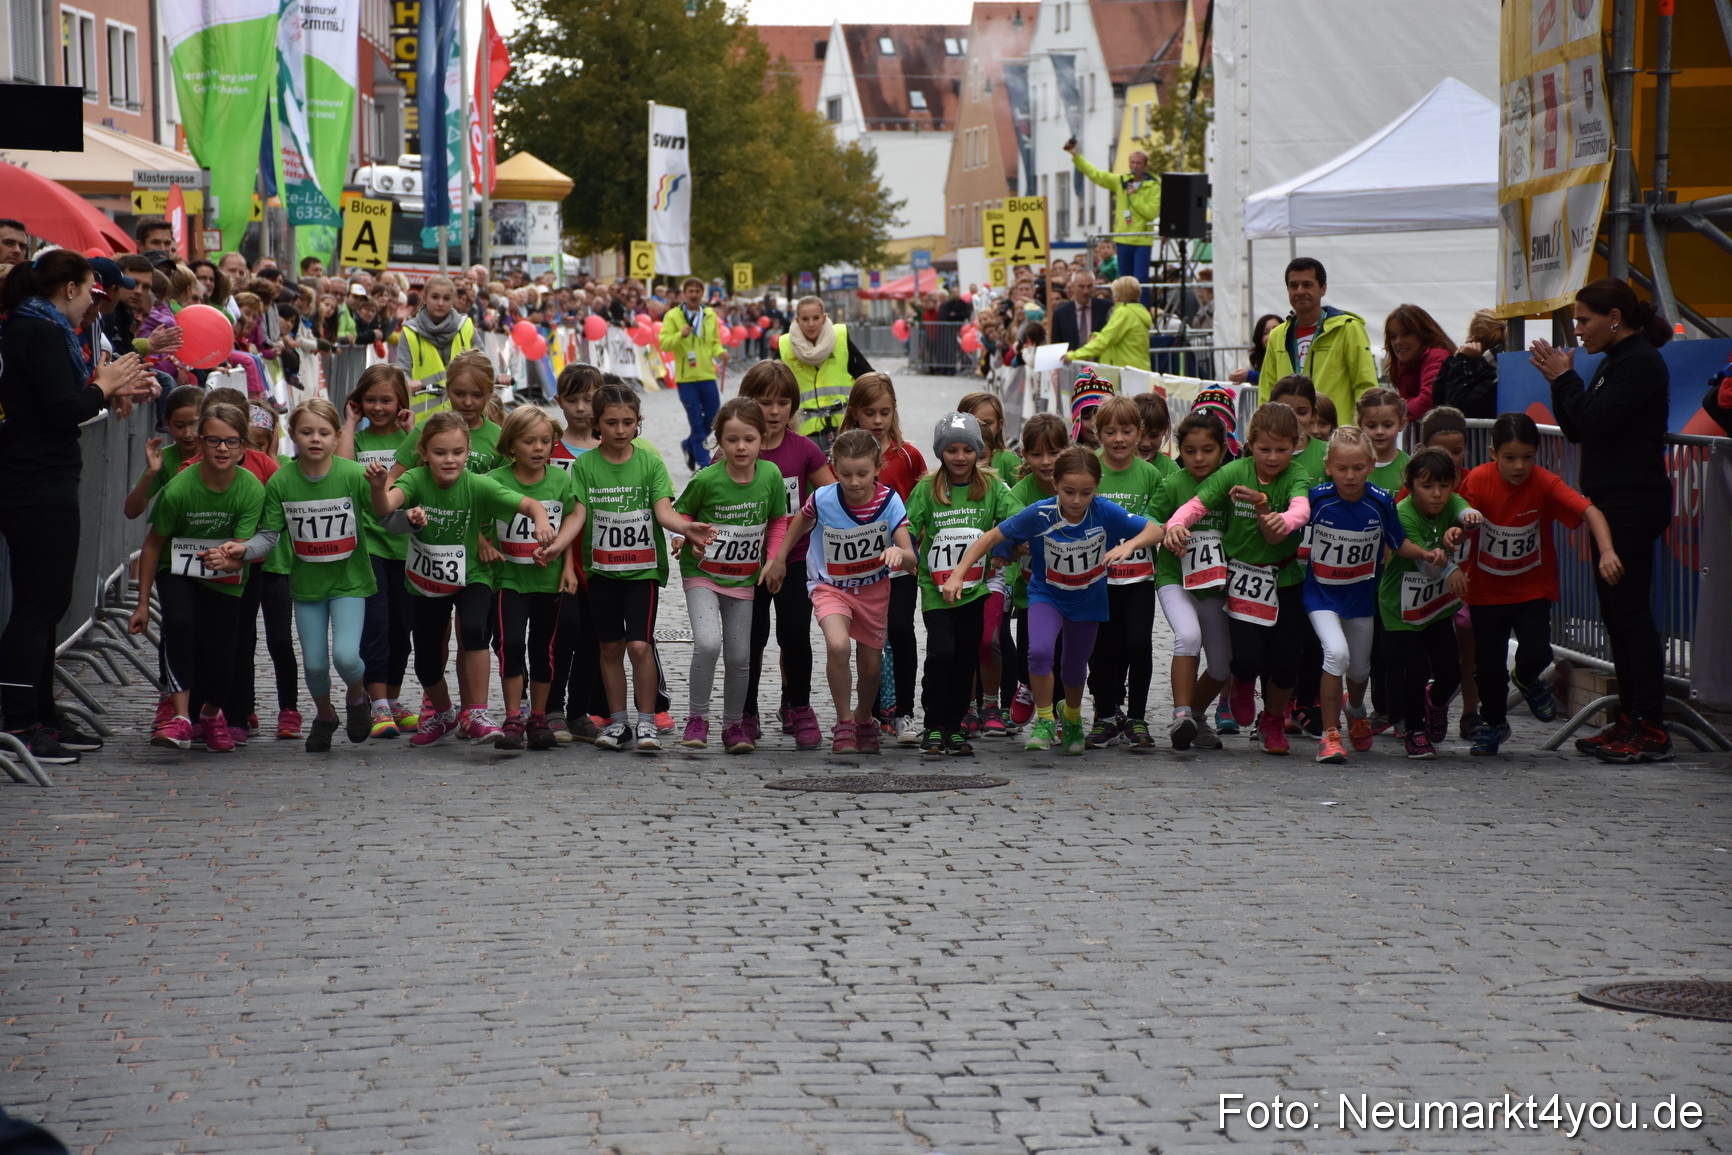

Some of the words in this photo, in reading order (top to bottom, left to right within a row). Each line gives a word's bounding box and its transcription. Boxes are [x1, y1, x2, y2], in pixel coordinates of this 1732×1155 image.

[653, 133, 686, 150] swn
[137, 172, 195, 184] Klostergasse
[351, 200, 387, 216] Block
[1008, 199, 1044, 212] Block
[352, 219, 378, 254] A
[1014, 217, 1040, 250] A
[1531, 233, 1550, 262] swn
[636, 252, 649, 270] C
[738, 270, 748, 284] D
[993, 269, 1003, 282] D
[588, 486, 633, 494] Neumarkter
[589, 495, 624, 503] Stadtlauf
[307, 505, 342, 513] Neumarkt
[715, 502, 758, 511] Neumarkter
[933, 507, 977, 518] Neumarkter
[594, 514, 612, 523] PARTL
[714, 510, 750, 519] Stadtlauf
[292, 513, 348, 539] 7177
[934, 516, 969, 527] Stadtlauf
[598, 524, 650, 548] 7084
[824, 531, 844, 540] PARTL
[845, 528, 877, 540] Neumarkt
[1315, 529, 1337, 541] PARTL
[1338, 535, 1371, 543] Neumarkt
[173, 543, 198, 551] PARTL
[308, 544, 339, 554] Cecilia
[713, 538, 761, 561] 7038
[829, 534, 886, 561] 7024
[1066, 541, 1097, 553] Neumarkt
[1486, 532, 1536, 557] 7138
[608, 553, 636, 562] Emilia
[932, 543, 968, 568] 717
[1320, 539, 1374, 565] 7180
[412, 548, 459, 583] 7053
[1050, 545, 1102, 573] 7117
[1496, 561, 1523, 569] Sarah
[844, 562, 876, 573] Sophia
[1227, 570, 1275, 602] 7437
[1404, 576, 1425, 584] PARTL
